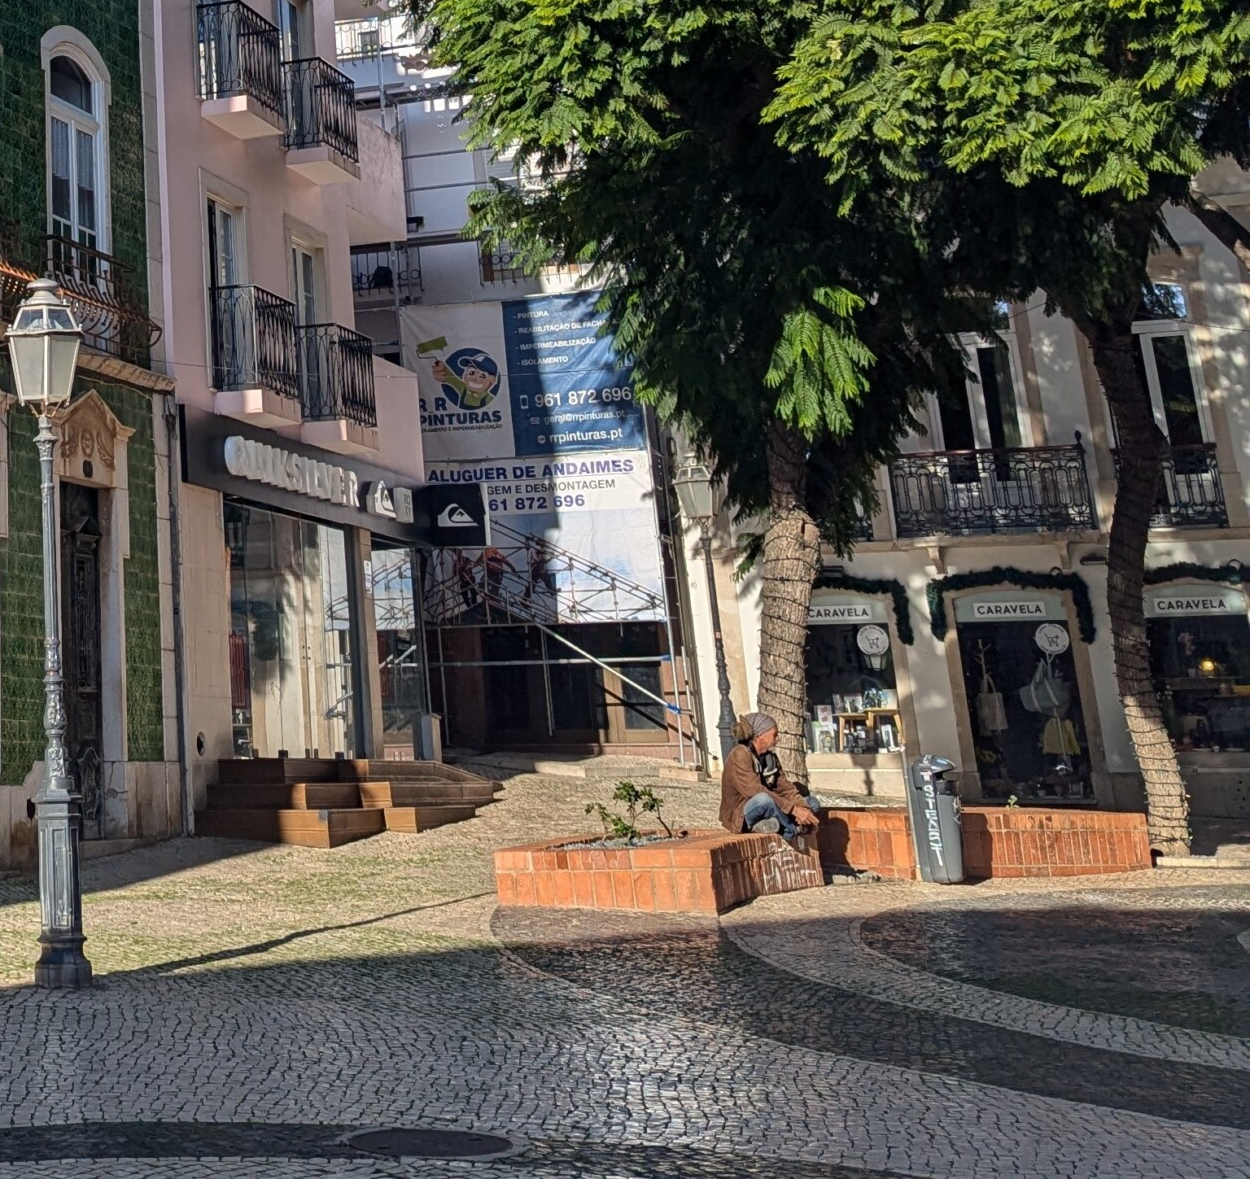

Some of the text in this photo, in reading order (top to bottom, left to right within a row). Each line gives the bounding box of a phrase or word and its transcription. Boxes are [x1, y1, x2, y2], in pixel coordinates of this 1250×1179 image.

[517, 310, 549, 319] PINTURA
[518, 322, 570, 334] REABILITAÇÃO
[519, 337, 597, 351] IMPERMEABILIZAÇÃO
[521, 355, 569, 366] ISOLAMENTO
[419, 396, 448, 412] R R
[534, 386, 632, 408] 961 872 696
[420, 410, 502, 426] PINTURAS
[549, 427, 623, 444] rrpinturas.pt
[428, 459, 634, 482] ALUGUER DE ANDAIMES
[487, 479, 616, 496] GEM E DESMONTAGEM
[488, 494, 585, 512] 61 872 696
[977, 604, 1043, 616] CARAVELA
[1157, 599, 1226, 610] CARAVELA
[808, 607, 869, 619] CARAVELA
